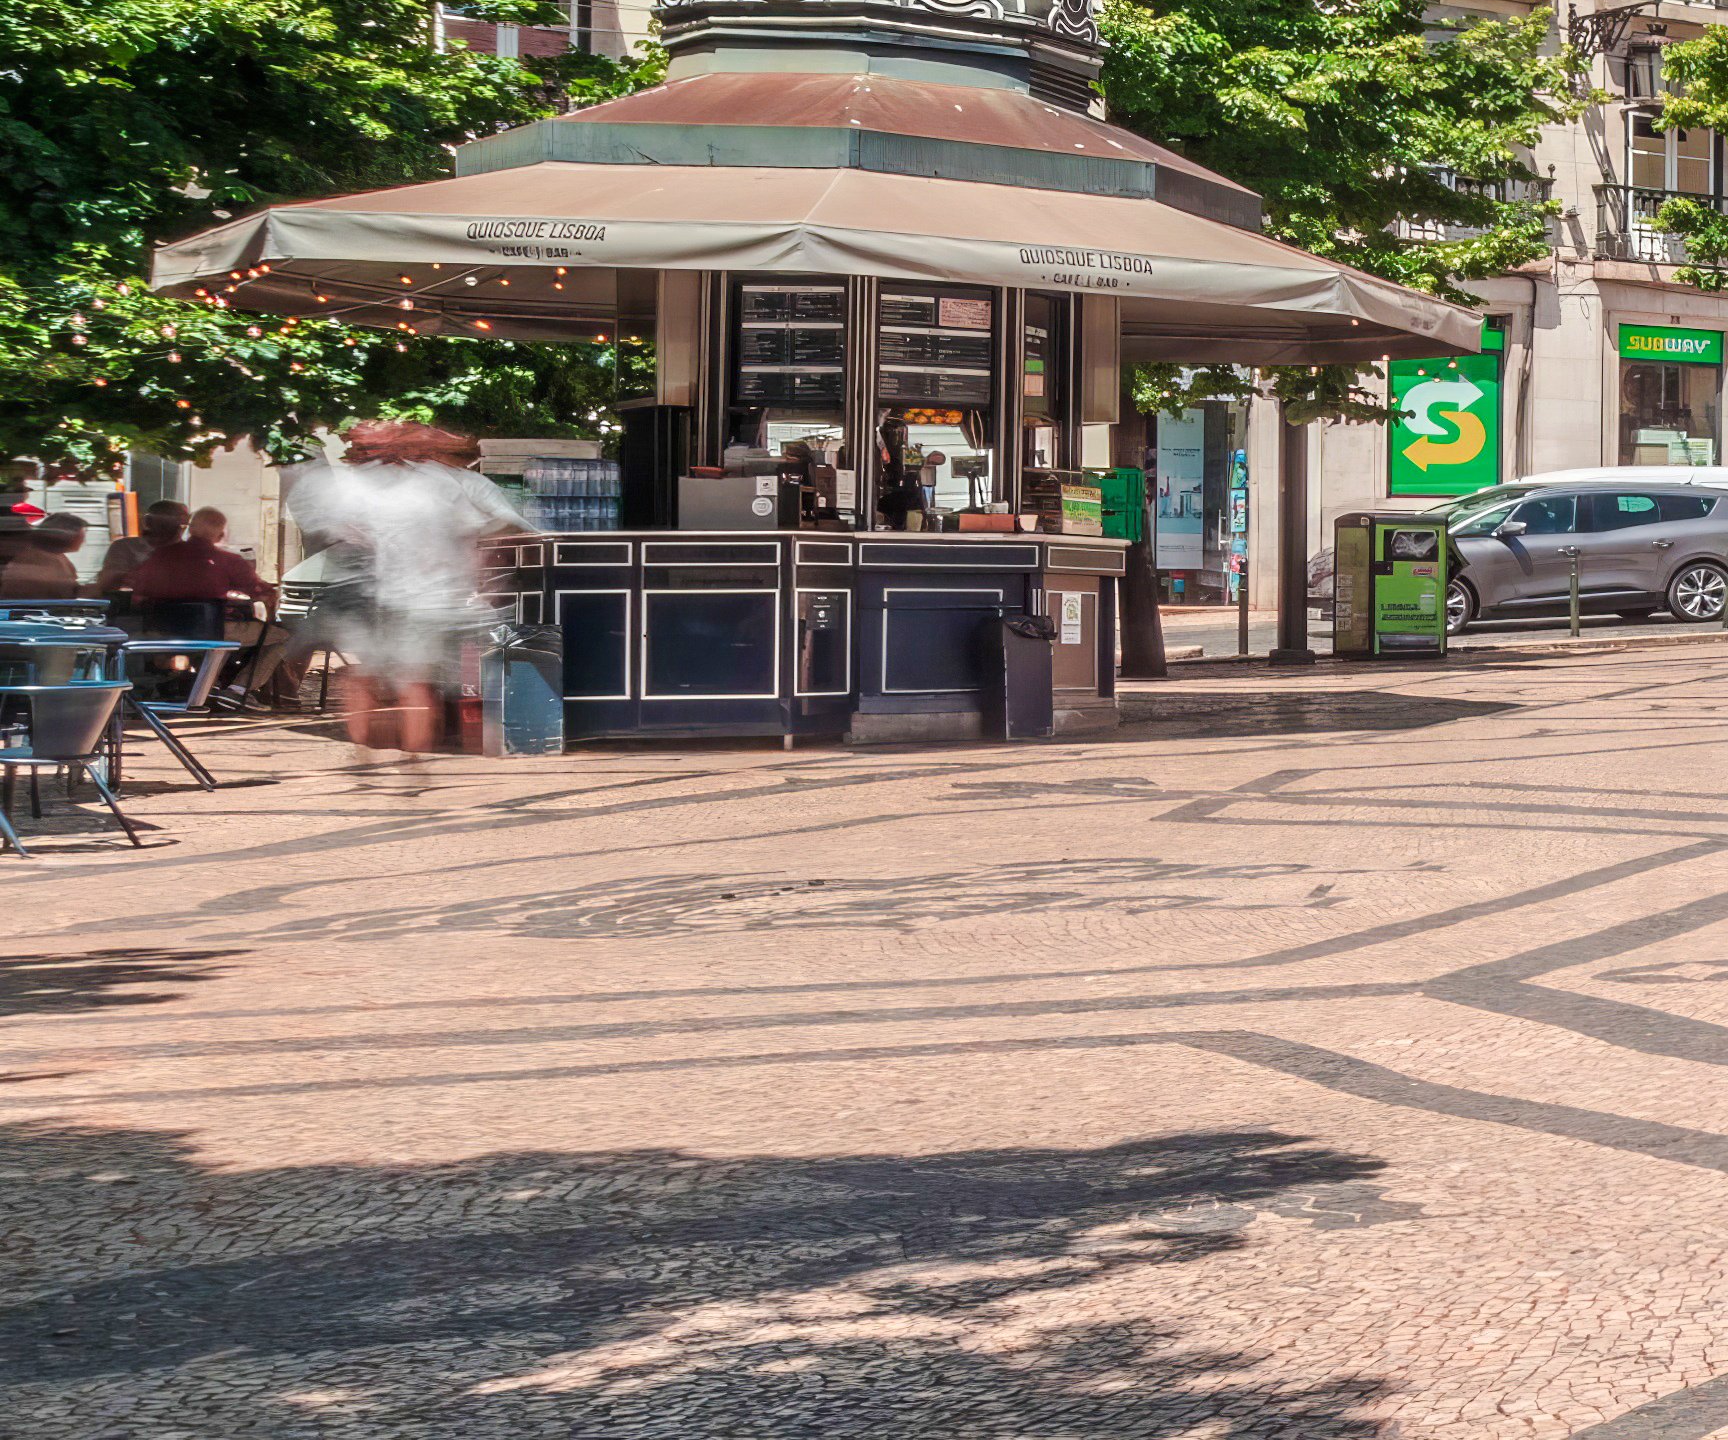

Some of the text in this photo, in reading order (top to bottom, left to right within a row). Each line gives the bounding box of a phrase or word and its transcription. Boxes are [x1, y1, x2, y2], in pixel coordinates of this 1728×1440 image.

[466, 221, 606, 241] QUIOSQUE LISBOA
[1019, 248, 1153, 275] QUIOSQUE LISBOA
